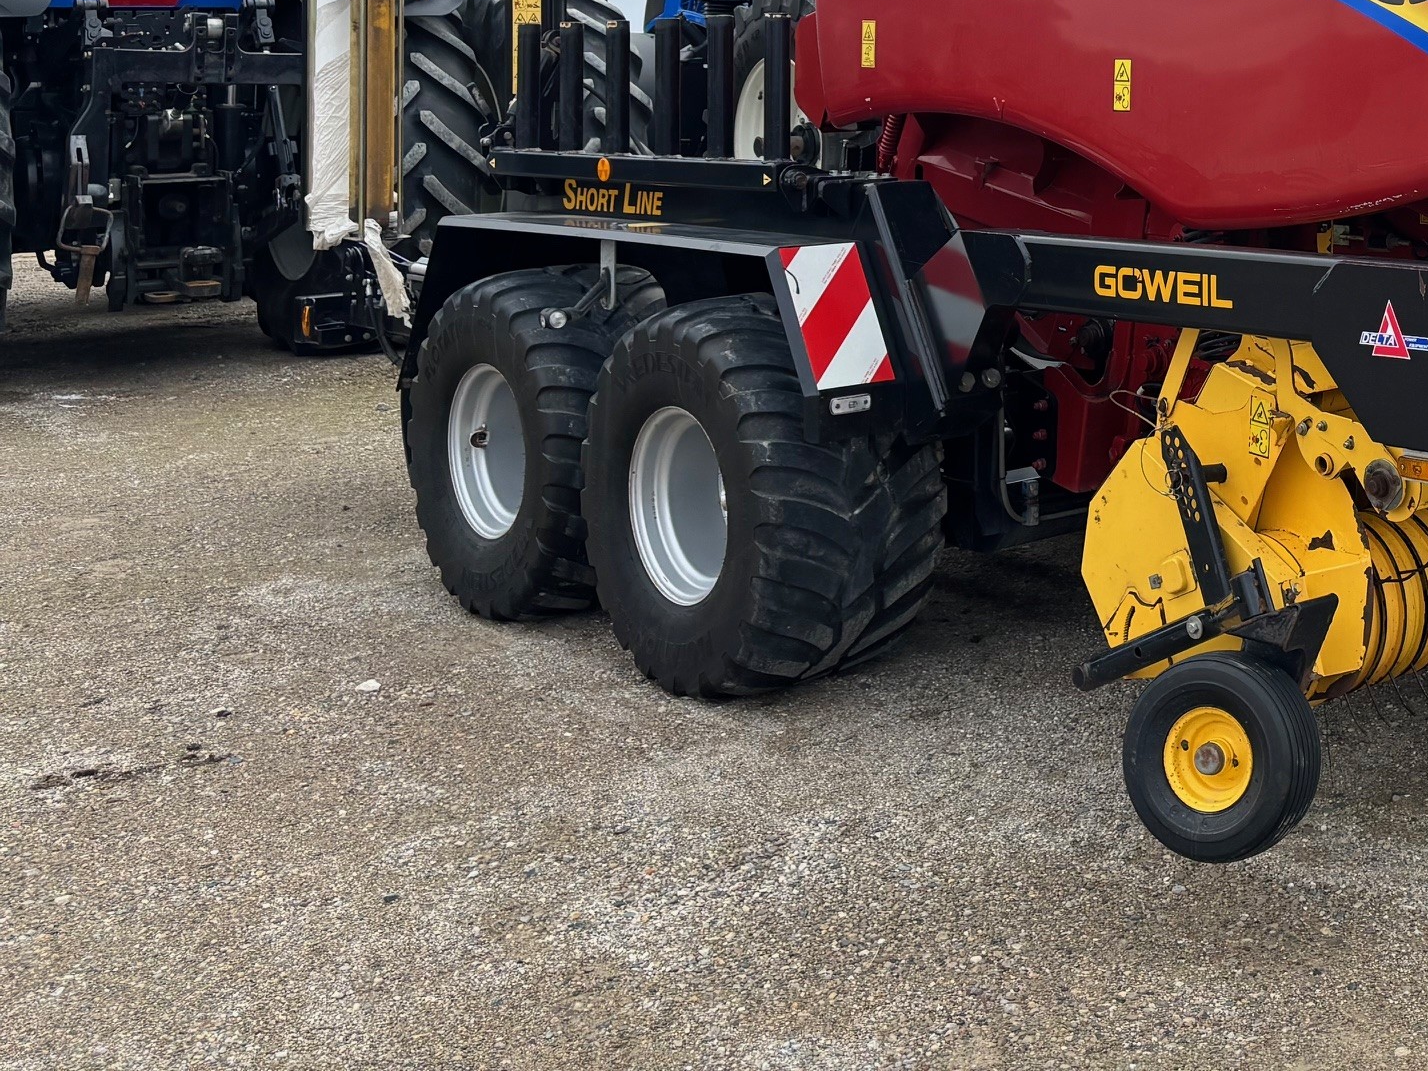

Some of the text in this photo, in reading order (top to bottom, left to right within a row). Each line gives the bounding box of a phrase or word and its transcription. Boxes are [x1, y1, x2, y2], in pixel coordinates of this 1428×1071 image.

[562, 178, 664, 216] SHORT LINE
[1361, 333, 1396, 346] DELTA
